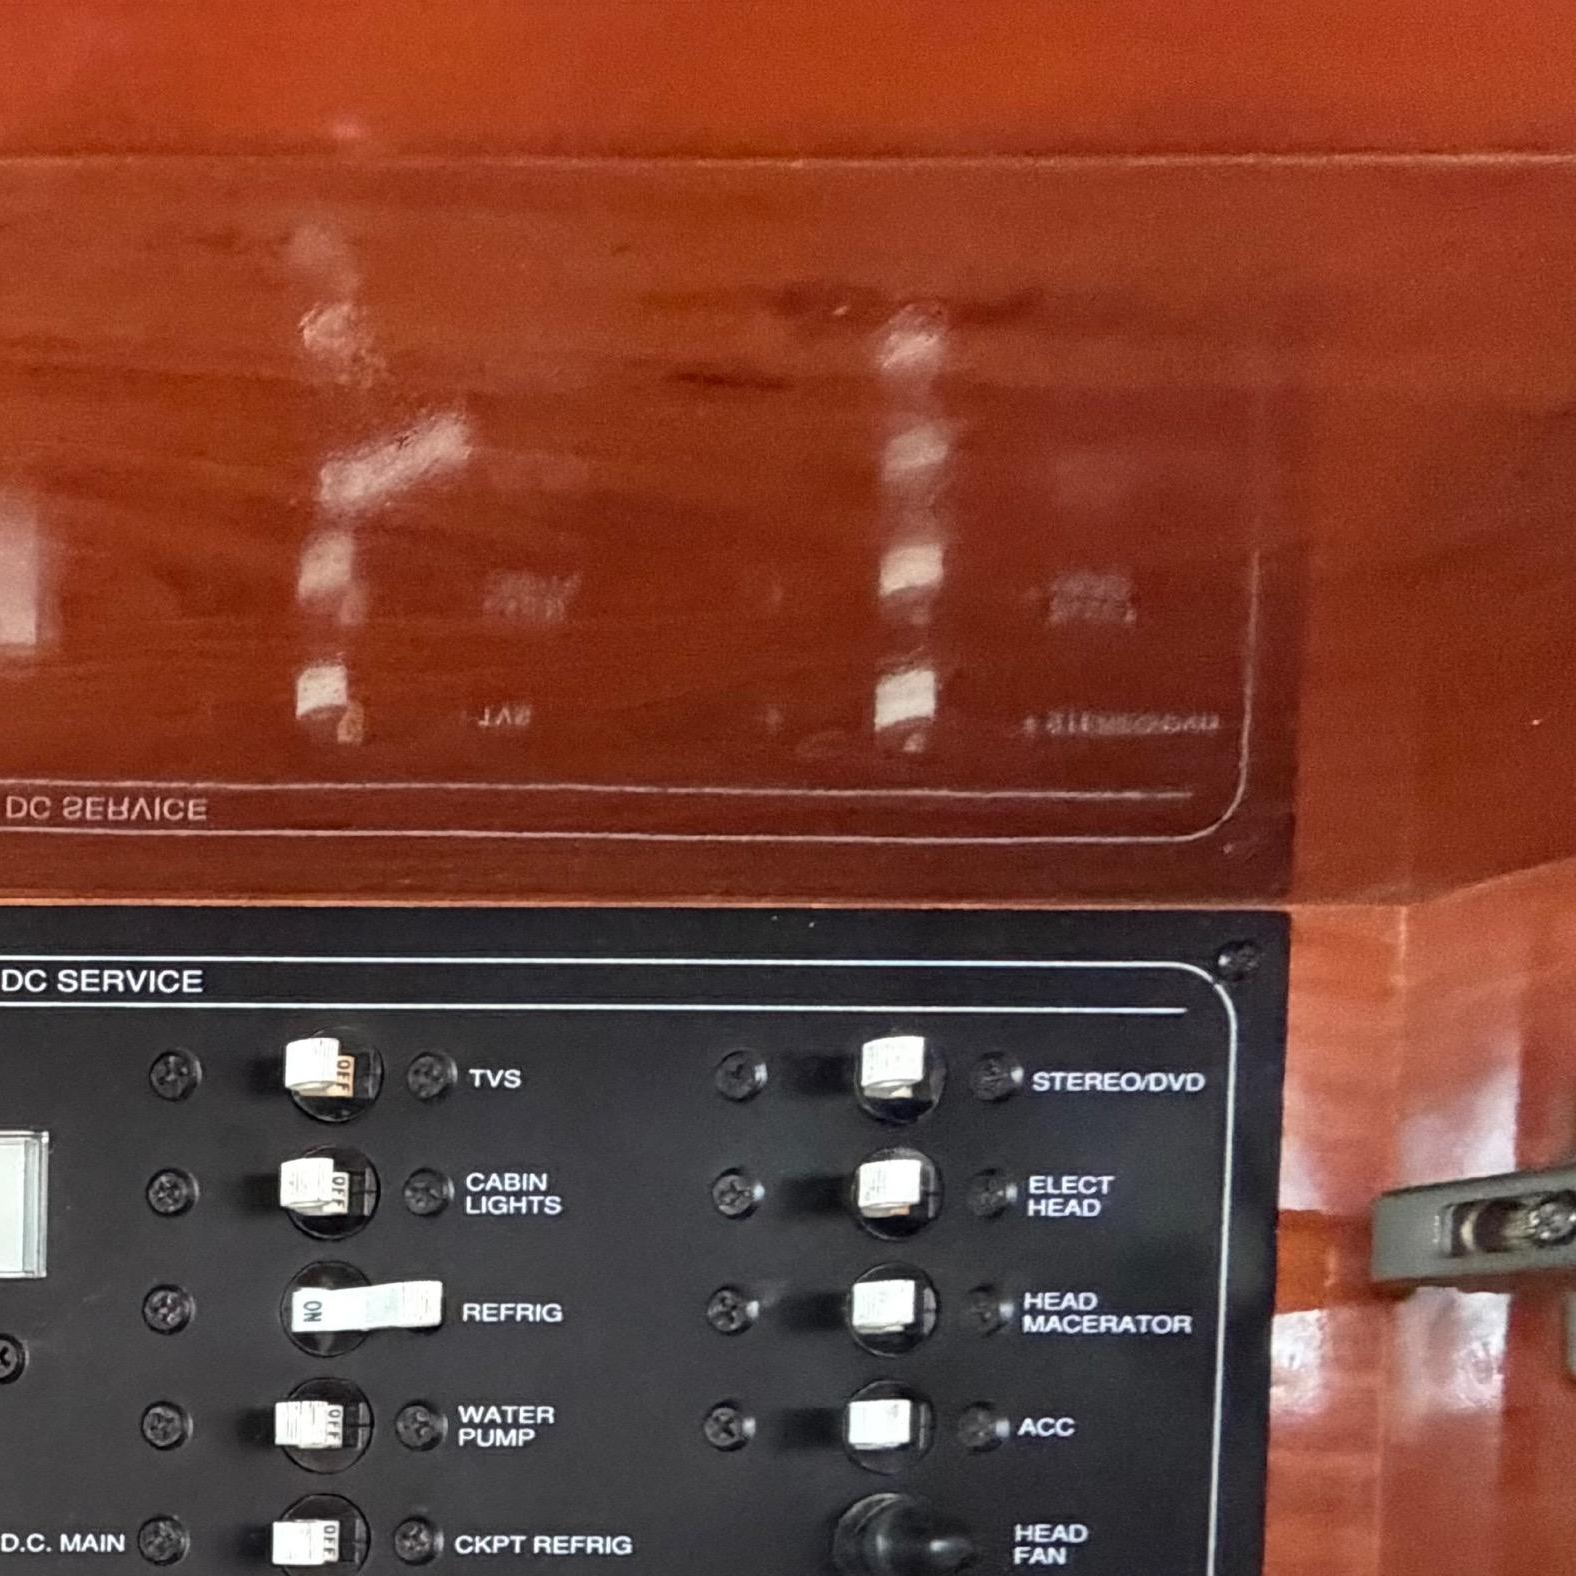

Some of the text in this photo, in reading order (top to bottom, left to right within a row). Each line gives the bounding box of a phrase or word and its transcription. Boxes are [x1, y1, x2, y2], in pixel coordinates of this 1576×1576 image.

[0, 968, 48, 993] DC
[56, 968, 204, 993] SERVICE
[468, 1068, 522, 1089] TVS
[1031, 1071, 1207, 1092] STEREO/DVD
[465, 1172, 548, 1192] CABIN
[1028, 1175, 1116, 1195] ELECT
[465, 1195, 563, 1215] LIGHTS
[1027, 1197, 1103, 1217] HEAD
[1023, 1291, 1099, 1311] HEAD
[303, 1300, 323, 1323] ON
[461, 1302, 563, 1322] REFRIG
[1021, 1314, 1193, 1334] MACERATOR
[457, 1405, 555, 1424] WATER
[1016, 1416, 1076, 1437] ACC
[457, 1427, 536, 1447] PUMP
[0, 1532, 126, 1553] D.C. MAIN
[1014, 1523, 1089, 1543] HEAD
[453, 1534, 633, 1555] CKPT REFRIG
[1013, 1546, 1067, 1565] FAN
